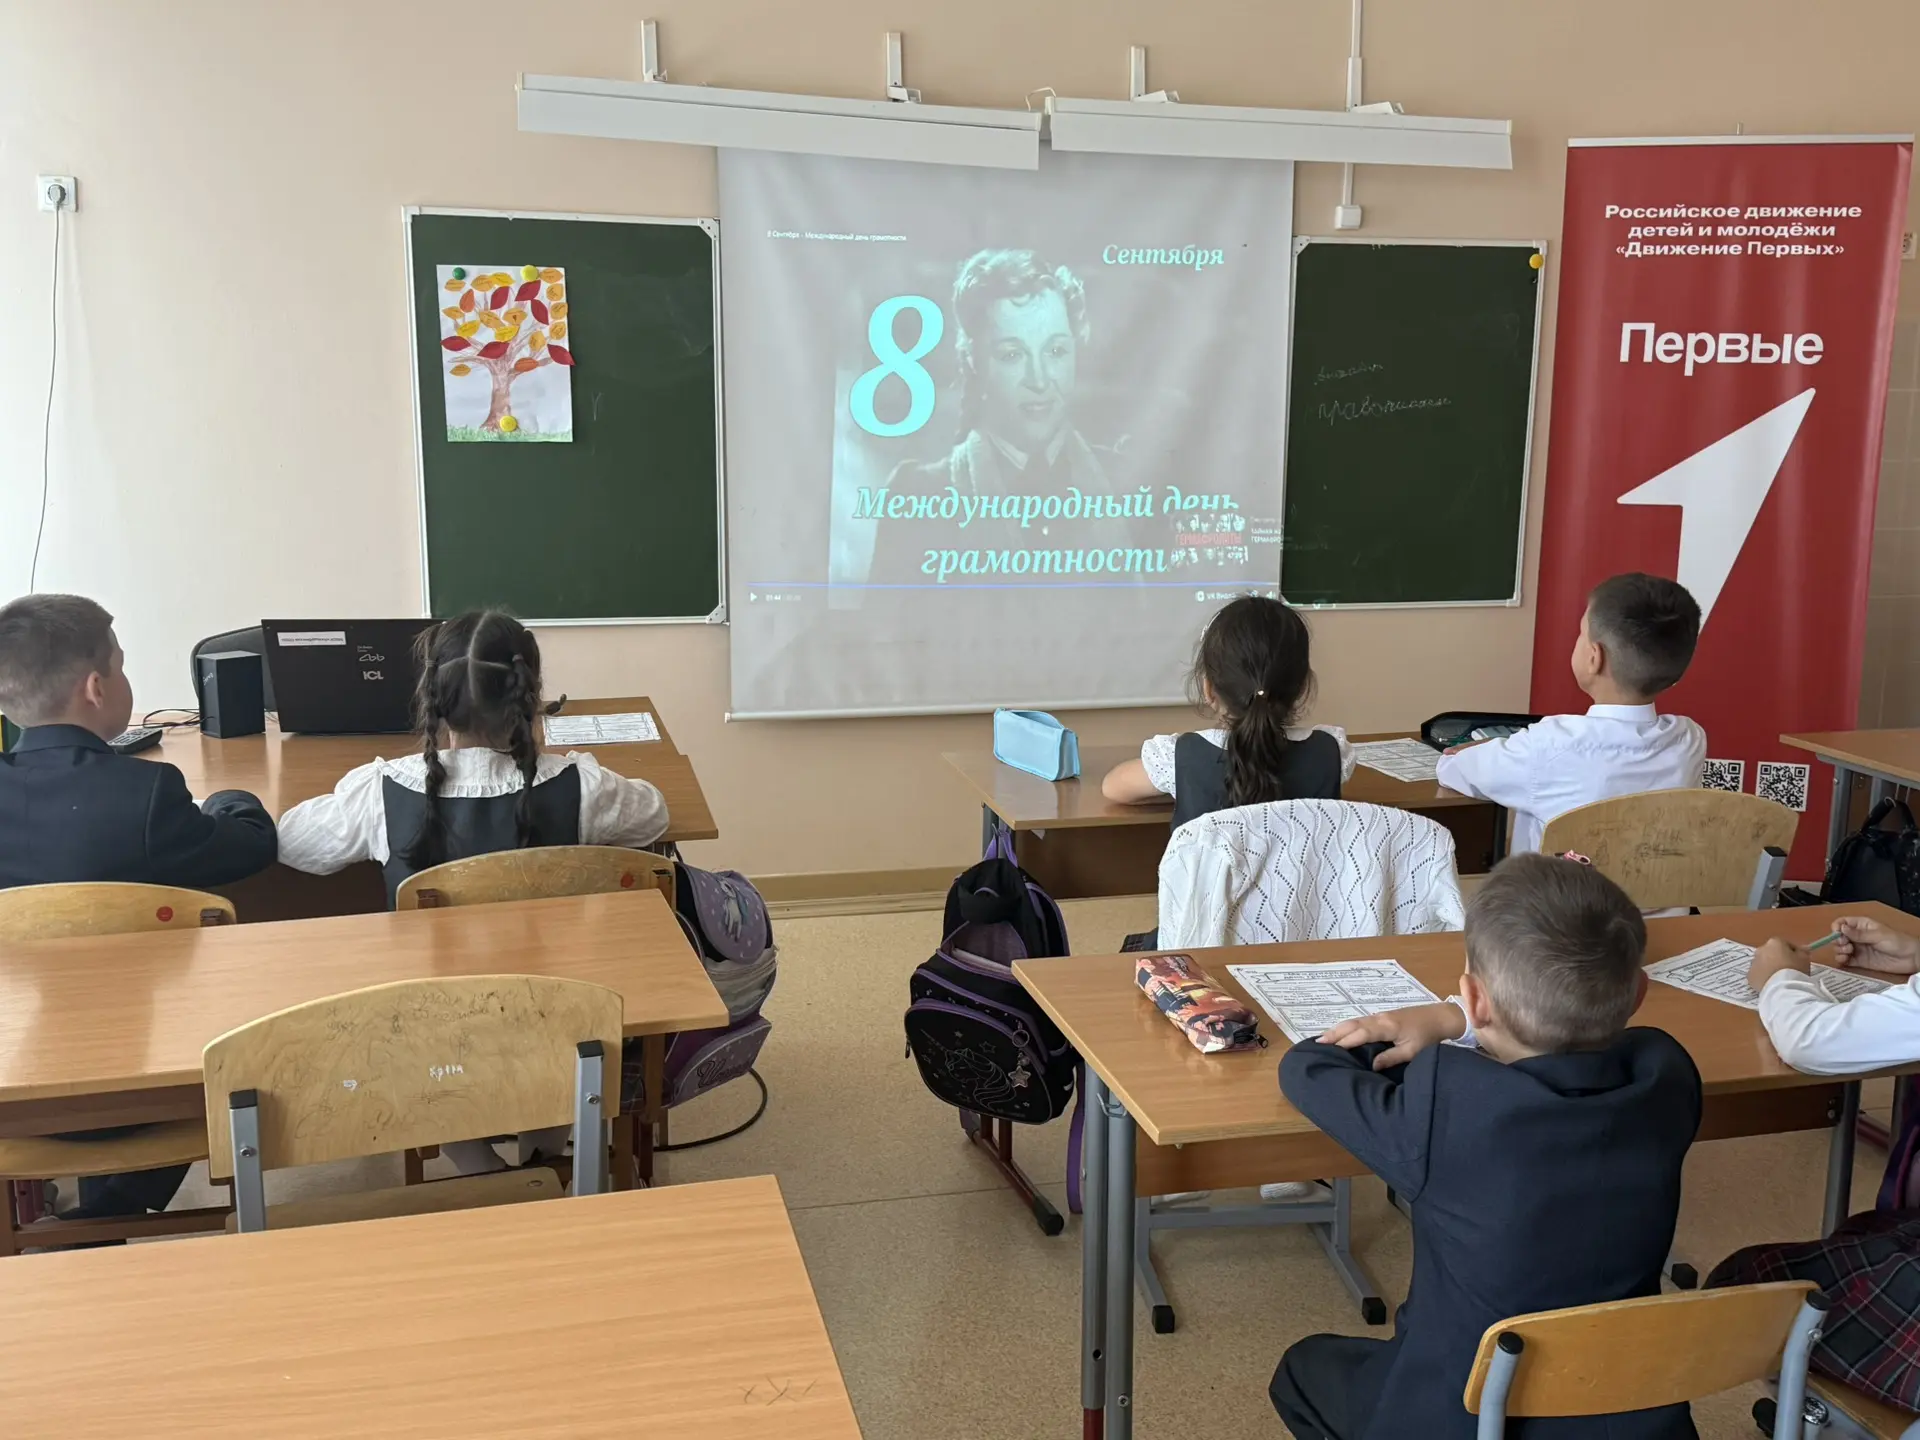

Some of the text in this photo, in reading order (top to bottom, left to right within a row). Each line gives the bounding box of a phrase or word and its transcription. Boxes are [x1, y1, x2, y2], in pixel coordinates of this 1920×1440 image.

[1605, 204, 1862, 219] Российское движение
[1628, 222, 1836, 239] детей и молодёжи
[1102, 244, 1224, 271] Сентября
[1616, 241, 1845, 258] «Движение Первых»
[1619, 322, 1824, 377] Первые
[849, 295, 944, 437] 8
[852, 485, 1154, 528] Международный
[362, 670, 384, 680] ICL
